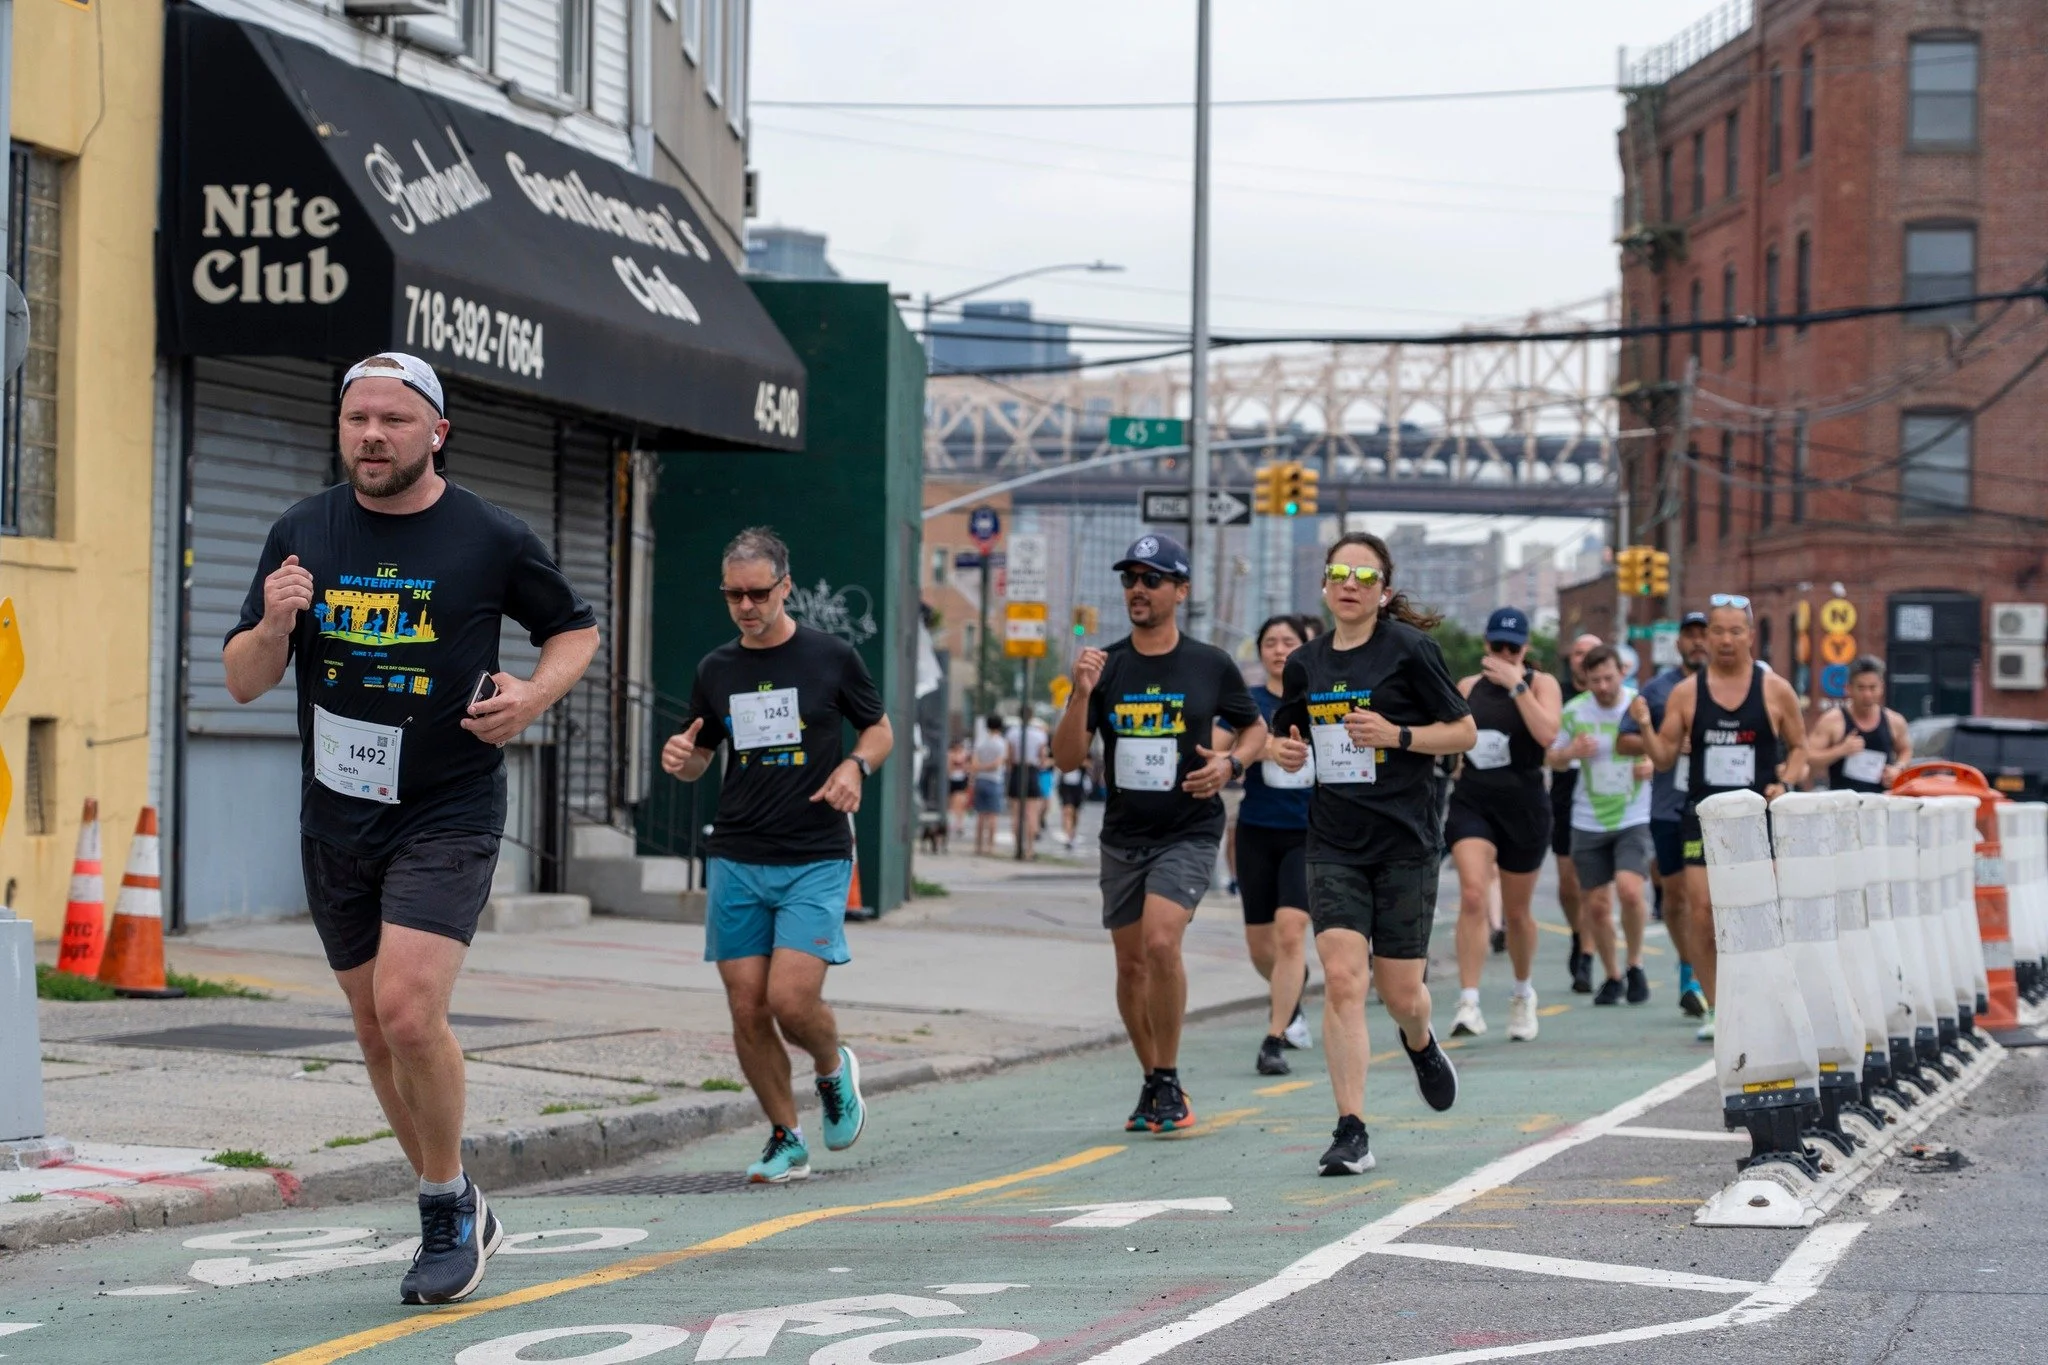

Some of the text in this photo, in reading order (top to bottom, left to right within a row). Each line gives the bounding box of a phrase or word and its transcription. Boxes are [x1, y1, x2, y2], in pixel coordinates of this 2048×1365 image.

[202, 183, 341, 239] Nite
[505, 151, 711, 262] Gentlemen's
[192, 245, 349, 305] Club
[612, 255, 700, 325] Club
[405, 284, 544, 380] 718-392-7664
[753, 380, 800, 438] 45-08
[1124, 420, 1149, 444] 45
[376, 567, 398, 578] LIC
[340, 575, 435, 590] WATERFRONT
[412, 589, 432, 600] 5K
[1146, 686, 1161, 695] LIC
[1310, 690, 1372, 701] WATERFRONT
[1332, 684, 1347, 692] LIC
[764, 706, 790, 719] 1243
[349, 744, 386, 766] 1492
[1145, 754, 1165, 767] 558
[338, 763, 359, 775] Seth
